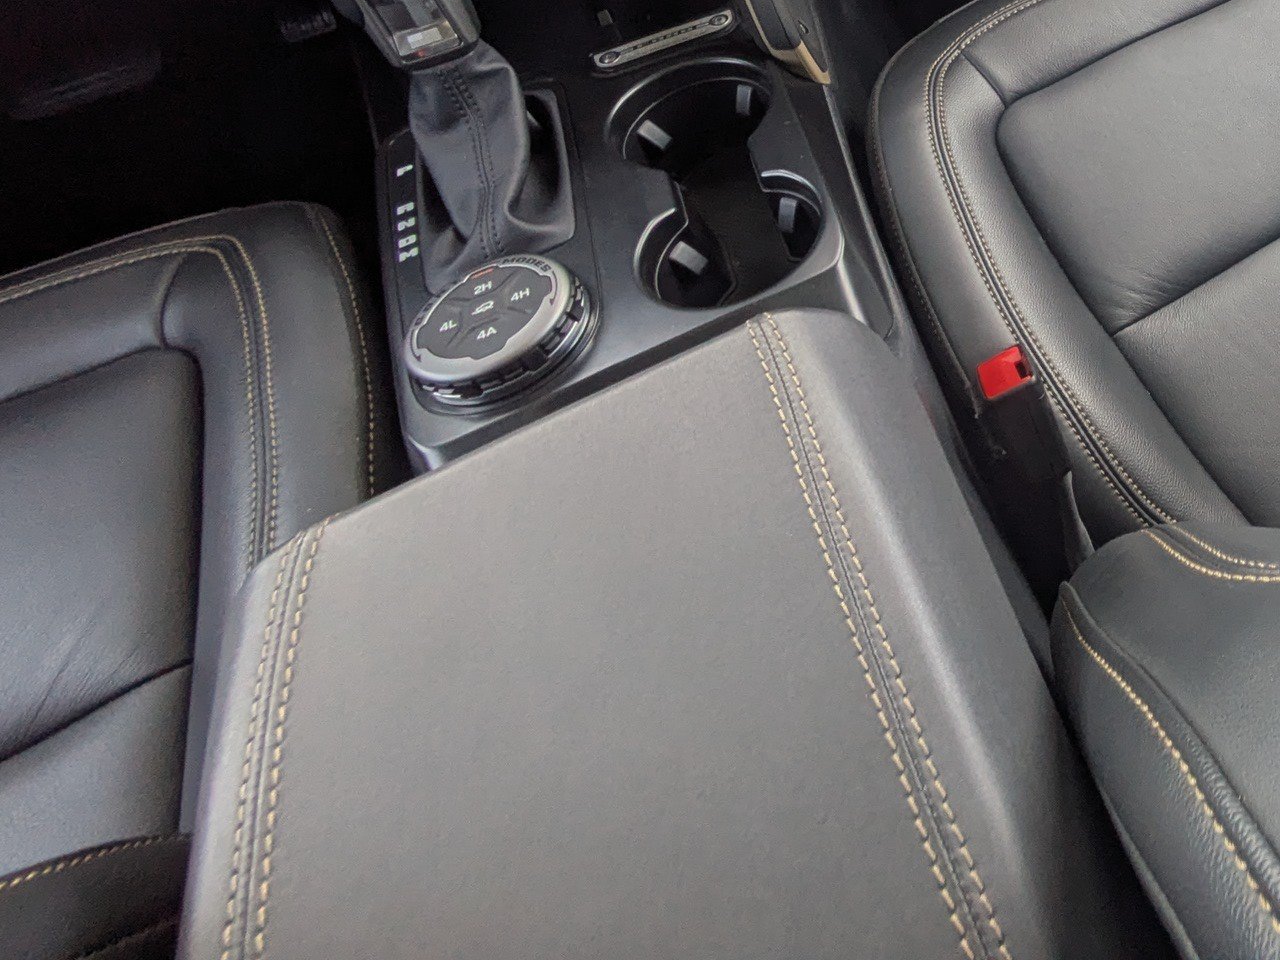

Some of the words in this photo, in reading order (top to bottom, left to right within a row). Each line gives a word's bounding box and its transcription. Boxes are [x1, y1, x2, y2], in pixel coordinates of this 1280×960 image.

[502, 257, 551, 272] MODES
[473, 280, 493, 295] 2H
[510, 287, 530, 302] 4H
[439, 320, 458, 332] 4L
[476, 326, 498, 340] 4A
